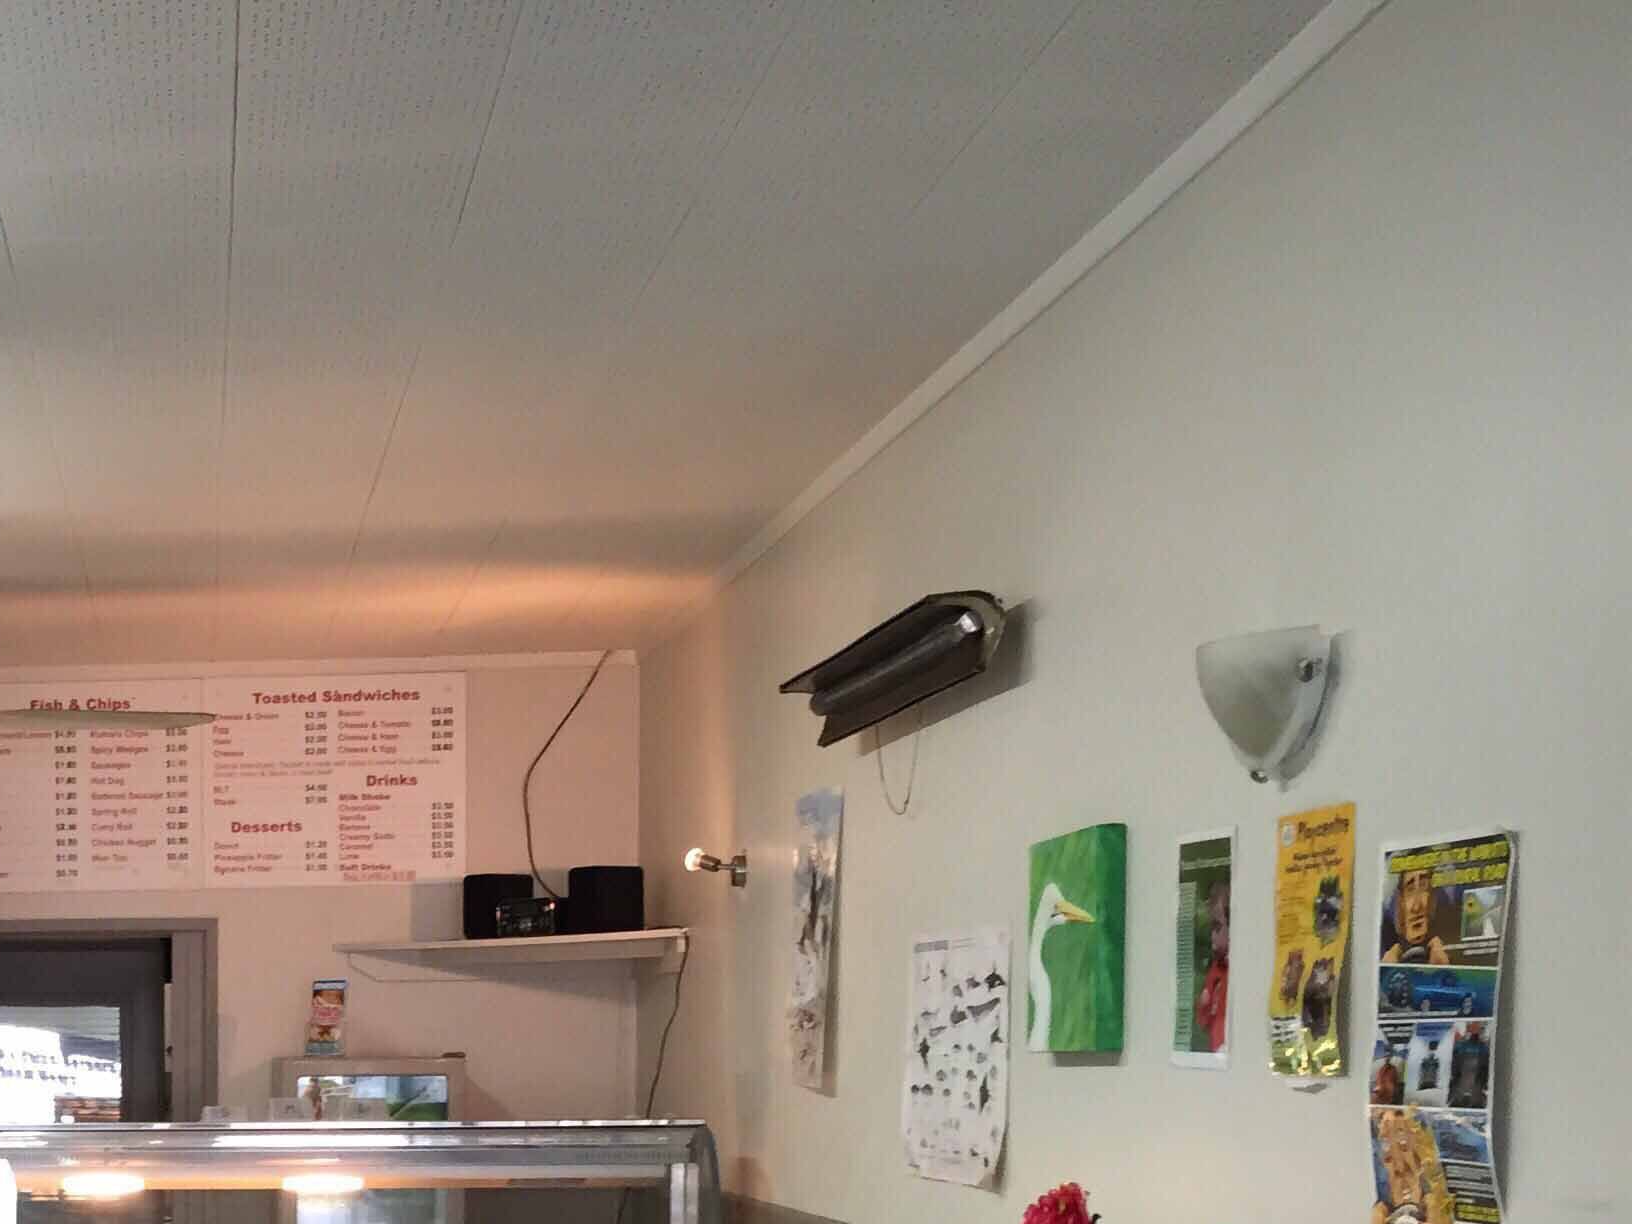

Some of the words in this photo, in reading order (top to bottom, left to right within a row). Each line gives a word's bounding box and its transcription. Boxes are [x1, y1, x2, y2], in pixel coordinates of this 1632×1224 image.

[252, 692, 317, 705] Toasted
[322, 689, 421, 704] Sandwiches
[30, 699, 63, 711] Fish
[68, 699, 81, 711] &
[86, 698, 131, 713] Chips
[366, 774, 418, 787] Drinks
[231, 820, 303, 833] Desserts
